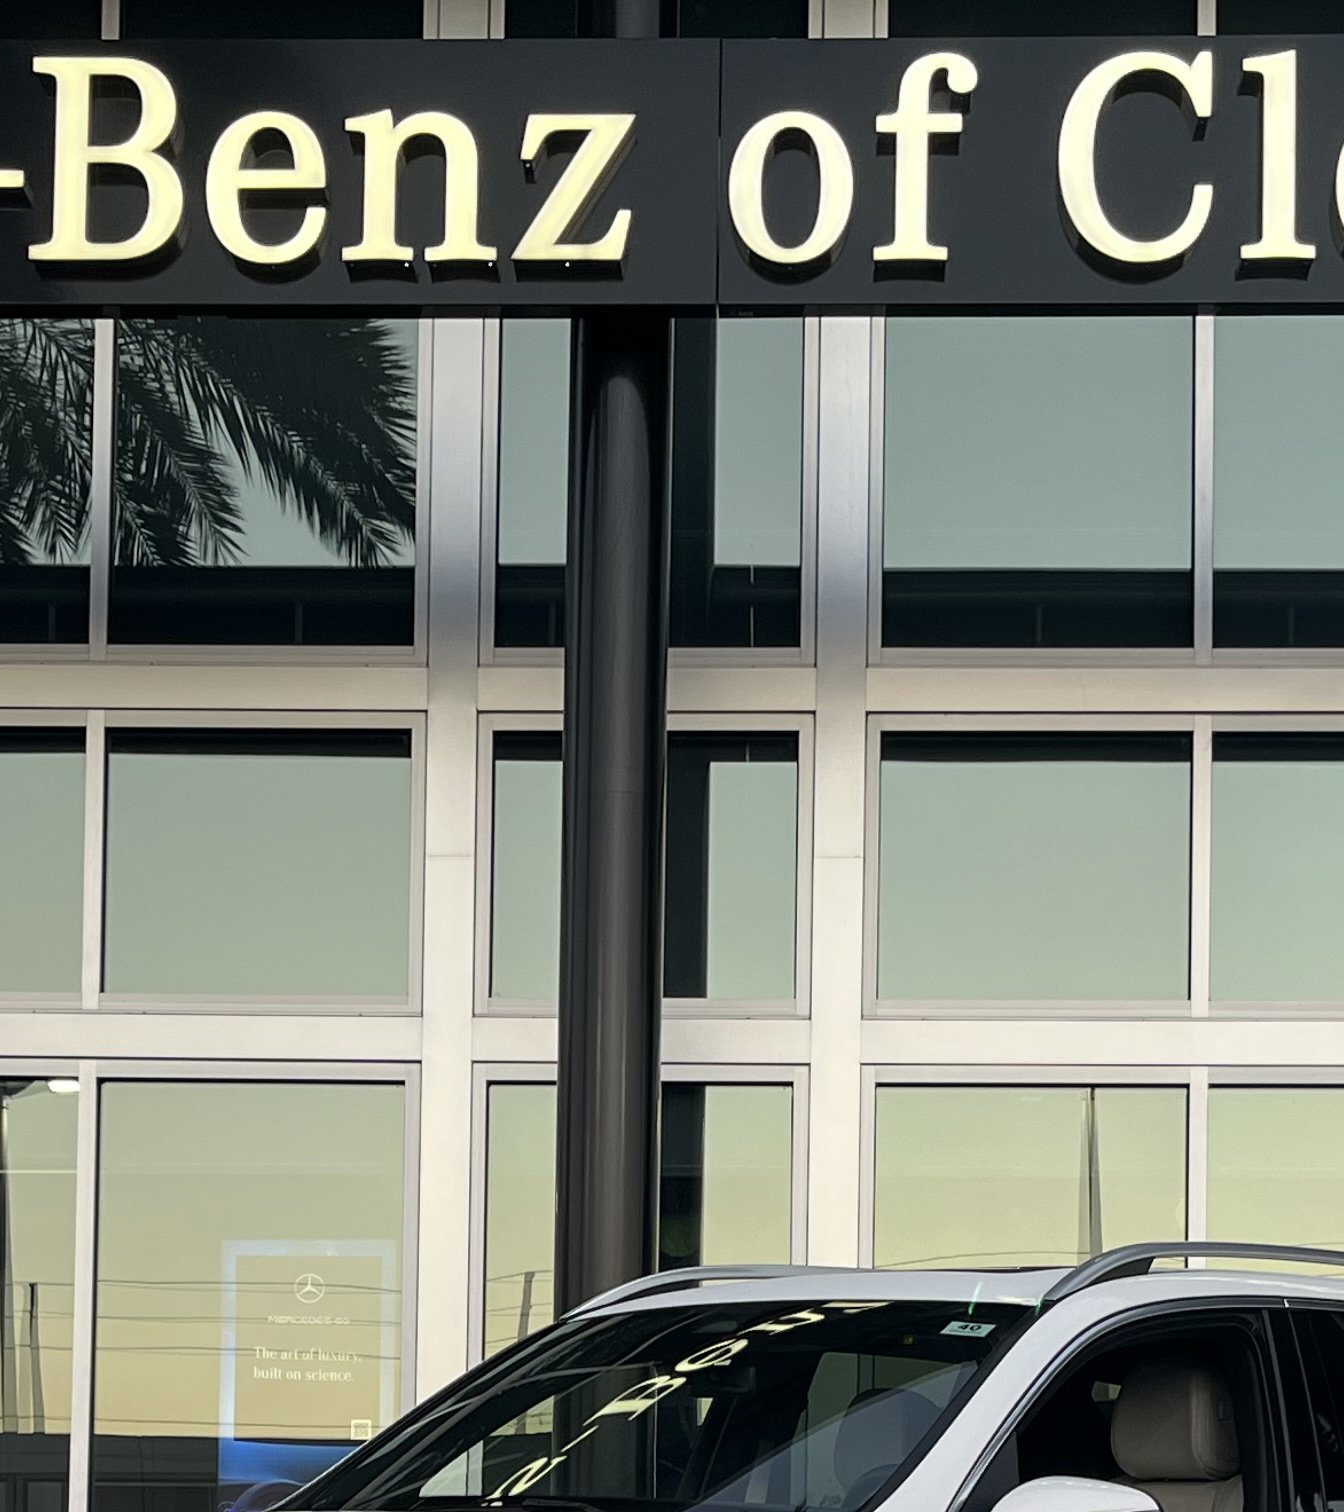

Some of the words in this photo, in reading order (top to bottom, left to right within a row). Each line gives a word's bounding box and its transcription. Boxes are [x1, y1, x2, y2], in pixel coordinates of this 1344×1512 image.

[729, 52, 978, 263] of
[253, 1346, 277, 1360] The
[280, 1349, 298, 1360] art
[302, 1347, 316, 1361] of
[318, 1347, 362, 1364] luxury,
[253, 1366, 282, 1380] built
[286, 1370, 301, 1381] on
[305, 1369, 354, 1382] science.
